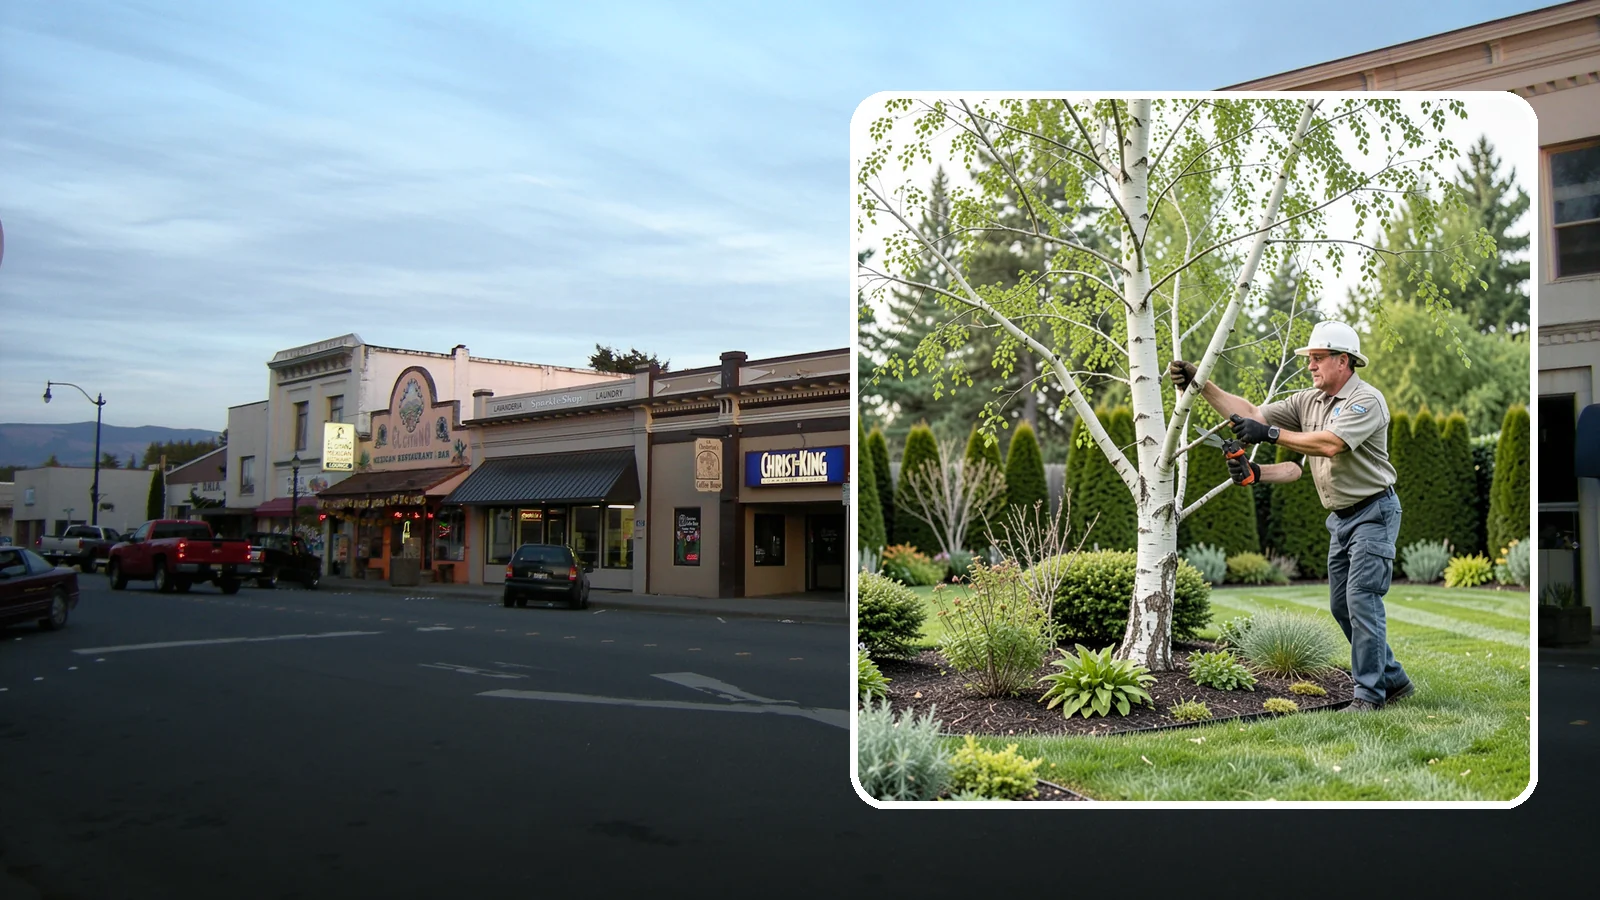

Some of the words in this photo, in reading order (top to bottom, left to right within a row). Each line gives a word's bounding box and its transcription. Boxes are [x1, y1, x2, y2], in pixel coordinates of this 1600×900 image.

[595, 388, 623, 400] LAUNDRY
[493, 401, 522, 413] LAVANDERIA
[531, 397, 560, 410] Sparkle
[561, 394, 583, 405] Shop
[374, 455, 396, 464] MEXICAN
[397, 451, 433, 462] RESTAURANT
[438, 450, 450, 458] BAR
[761, 452, 797, 478] CHRIST
[799, 450, 827, 476] KING
[696, 480, 709, 488] Coffee
[709, 480, 721, 488] House
